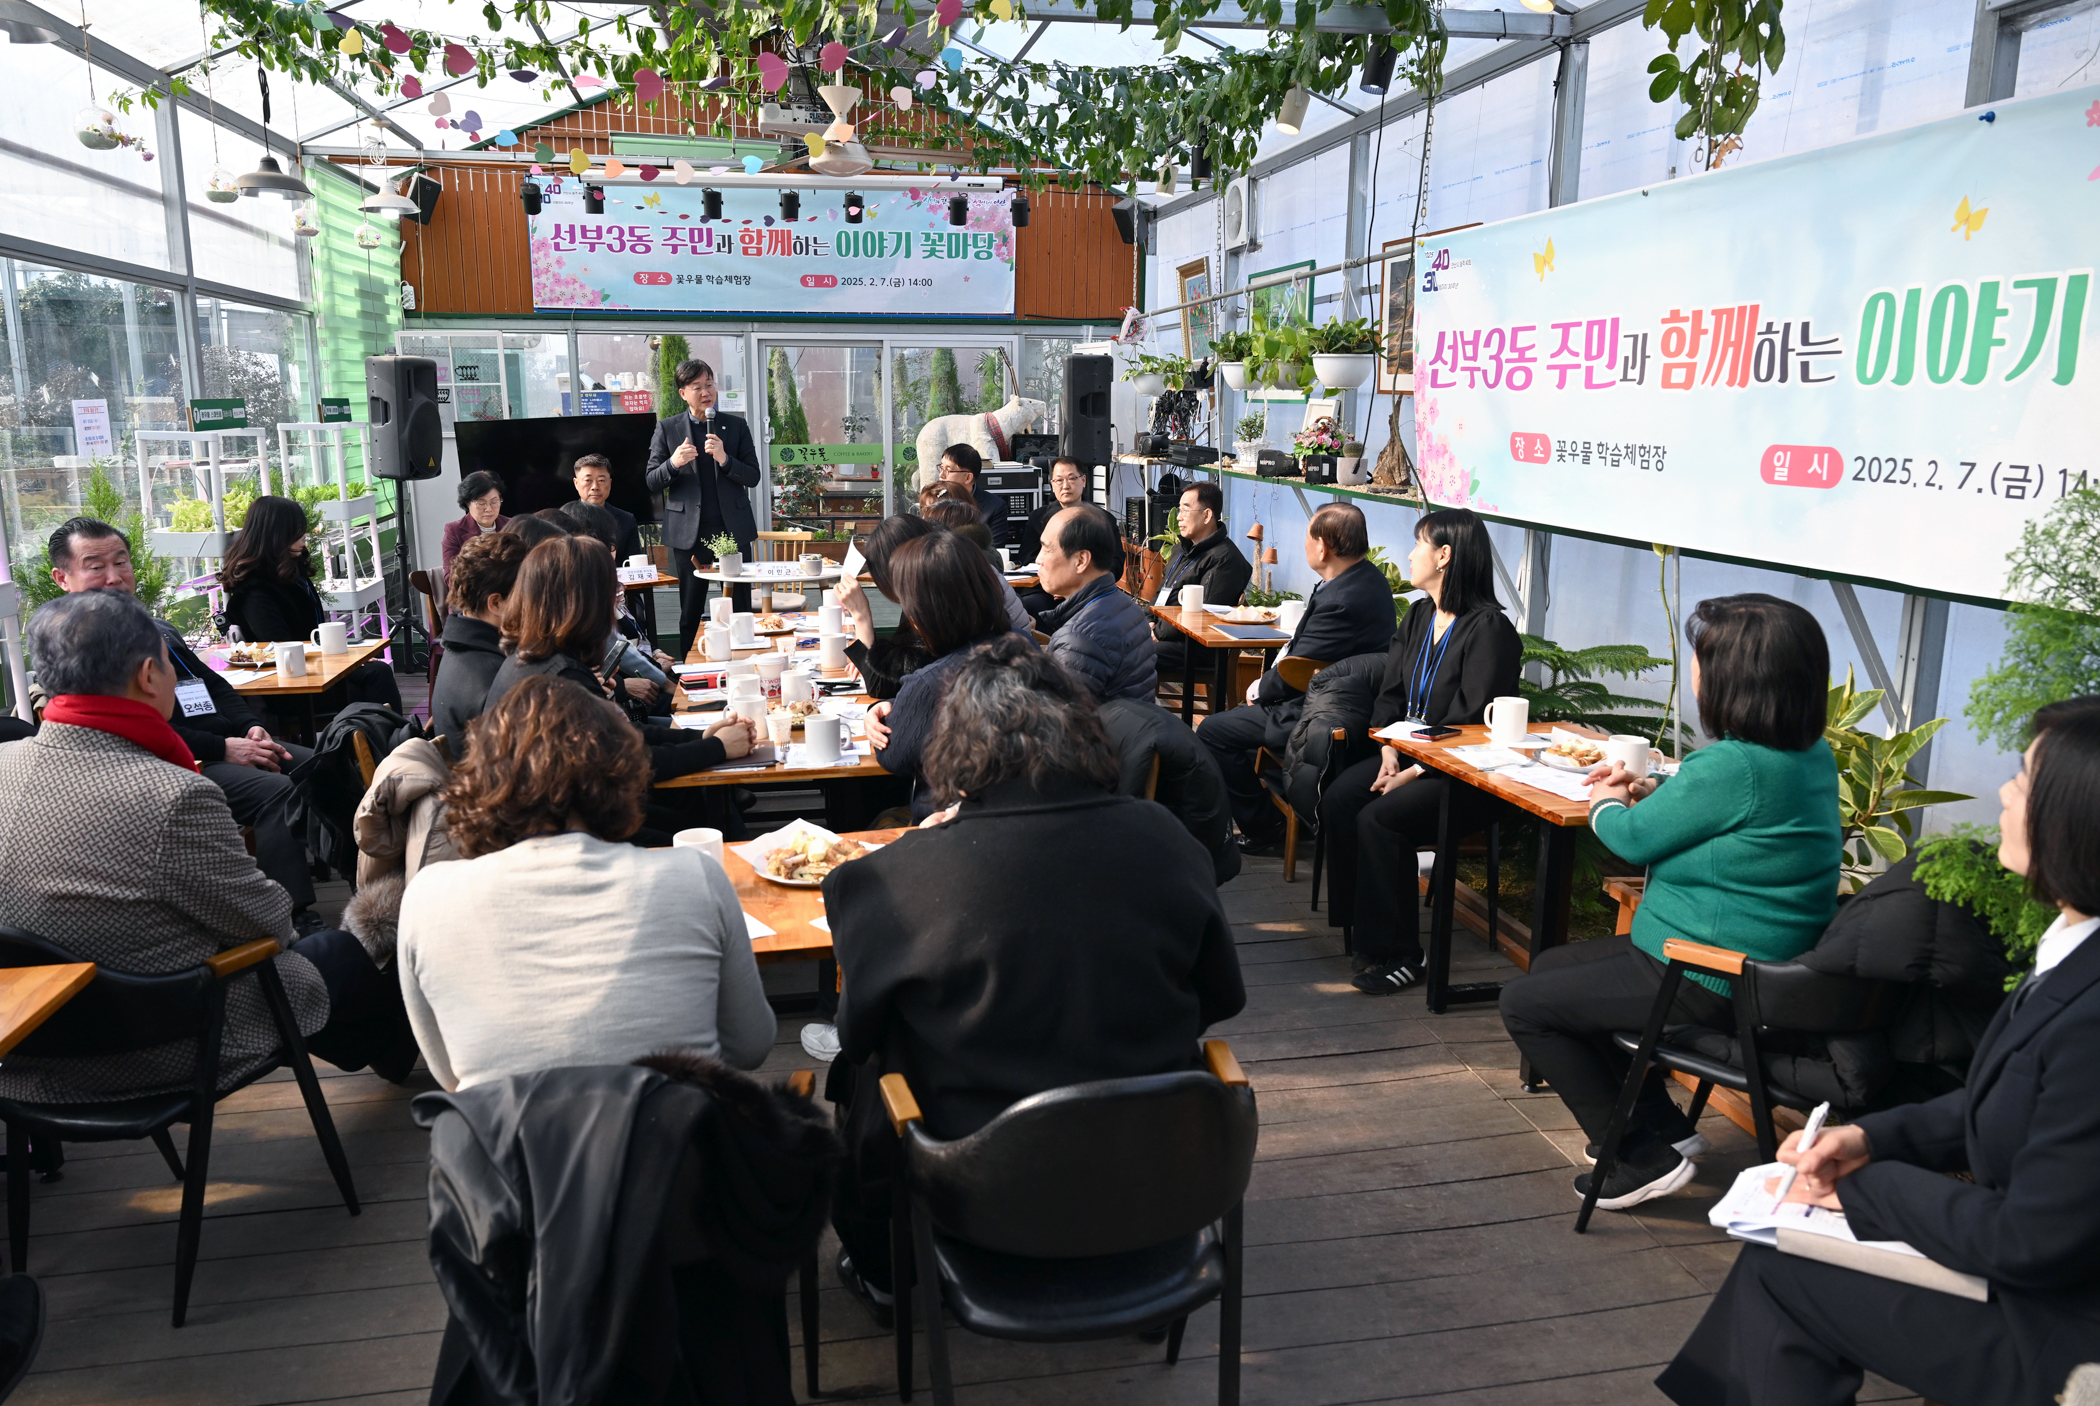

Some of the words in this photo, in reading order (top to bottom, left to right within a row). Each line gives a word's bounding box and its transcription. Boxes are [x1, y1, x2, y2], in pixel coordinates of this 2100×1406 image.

[550, 223, 653, 255] 선부3동
[661, 226, 734, 256] 주민과
[738, 227, 831, 258] 함께하는
[836, 230, 912, 260] 이야기
[920, 230, 998, 261] 꽃마당
[1432, 248, 1450, 271] 40
[675, 273, 704, 288] 꽃우물
[705, 273, 752, 288] 학습체험장
[841, 276, 867, 288] 2025.
[869, 276, 879, 288] 2.
[908, 276, 933, 288] 14:00
[1428, 325, 1538, 392] 선부3동
[1545, 316, 1651, 391] 주민과
[1659, 303, 1843, 391] 함께하는
[1855, 273, 2090, 387] 이야기
[797, 446, 830, 463] 꽃우물
[1259, 457, 1276, 466] MIPRO
[1555, 439, 1594, 466] 꽃우물
[1596, 440, 1668, 473] 학습체험장
[1852, 455, 1917, 488] 2025.
[1925, 460, 1945, 491] 2.
[184, 701, 213, 713] 오석종
